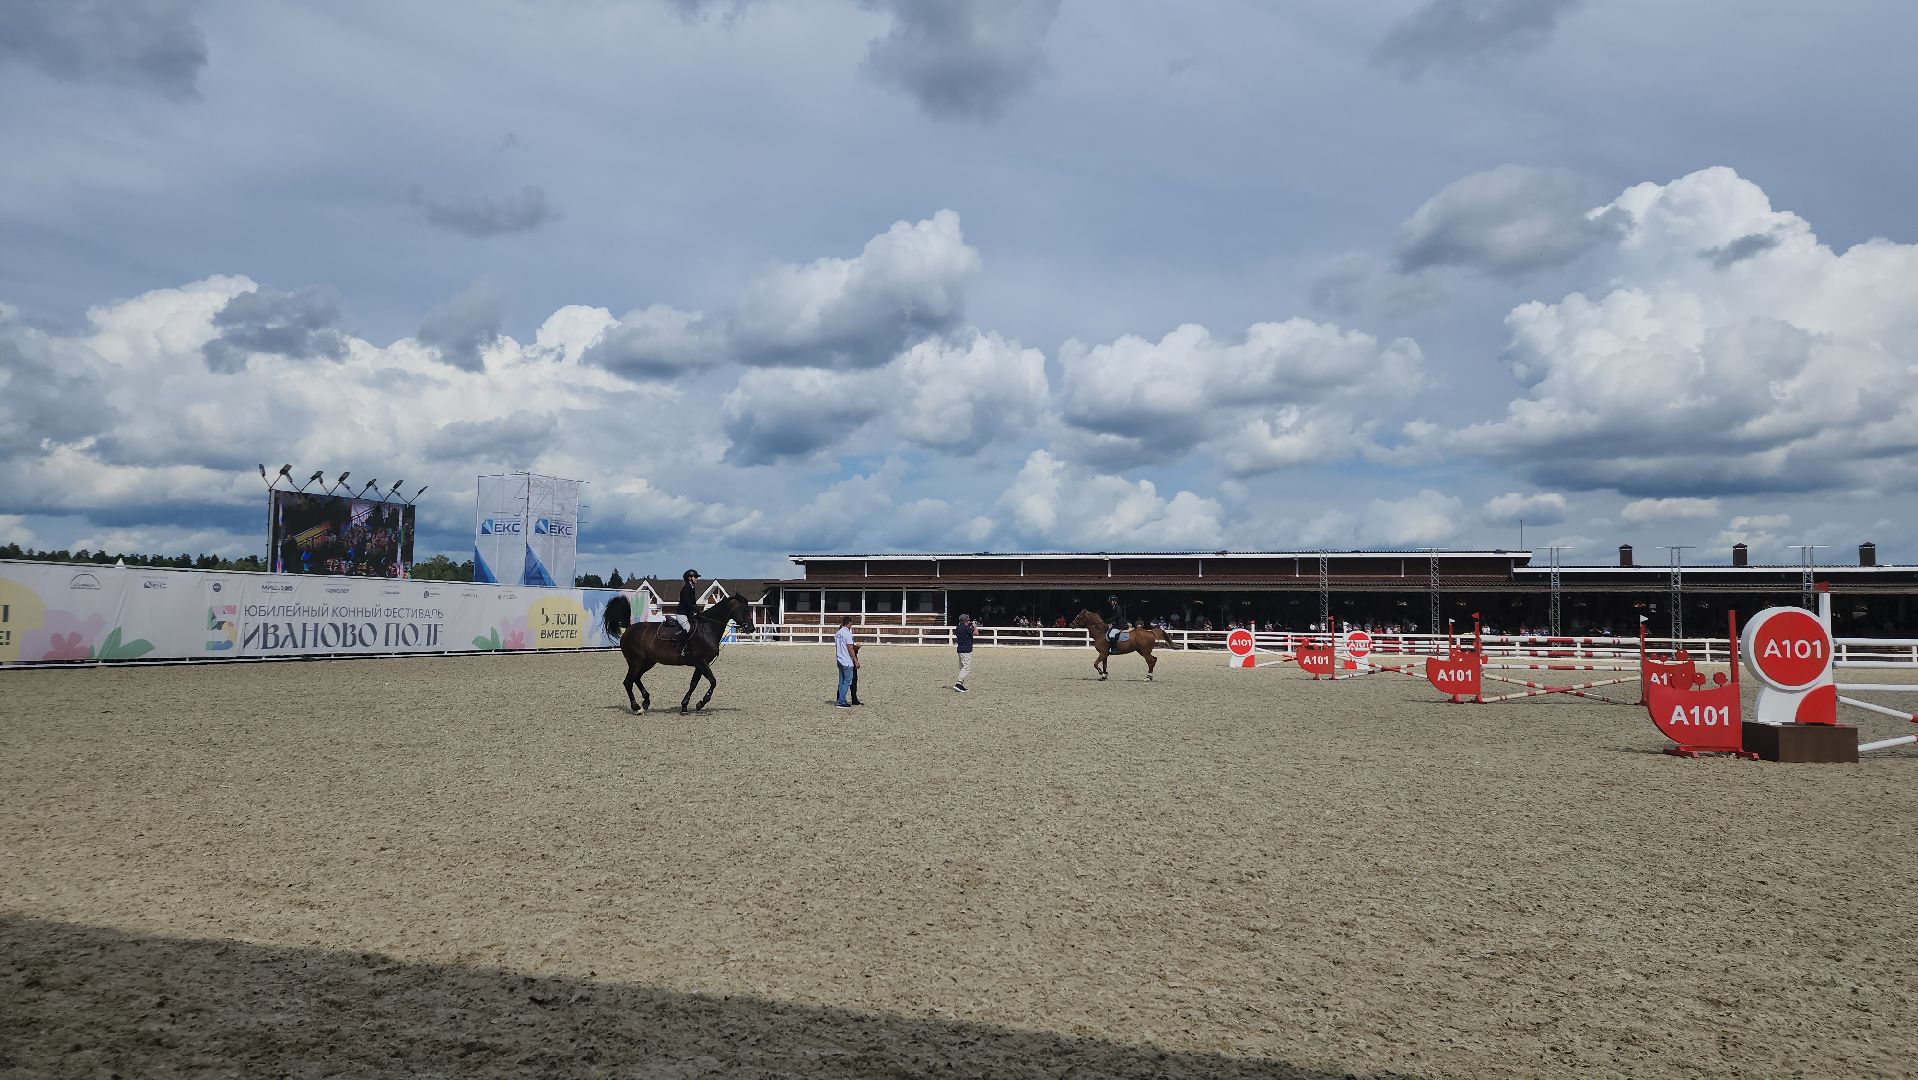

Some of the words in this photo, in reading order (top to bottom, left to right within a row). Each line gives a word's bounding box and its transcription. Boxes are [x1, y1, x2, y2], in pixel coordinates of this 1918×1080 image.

[494, 523, 520, 533] ЕКС
[244, 602, 329, 618] ЮБИЛЕЙНЫЙ
[331, 603, 382, 618] КОННЫЙ
[383, 607, 444, 619] ФЕСТИВАЛЬ
[242, 622, 378, 650] ИВАНОВО
[384, 622, 444, 647] ПОЛЕ
[540, 629, 578, 639] ВМЕСТЕ!
[1763, 638, 1822, 659] A101
[1303, 655, 1329, 665] A101
[1437, 669, 1472, 682] A101
[1669, 704, 1729, 727] A101
